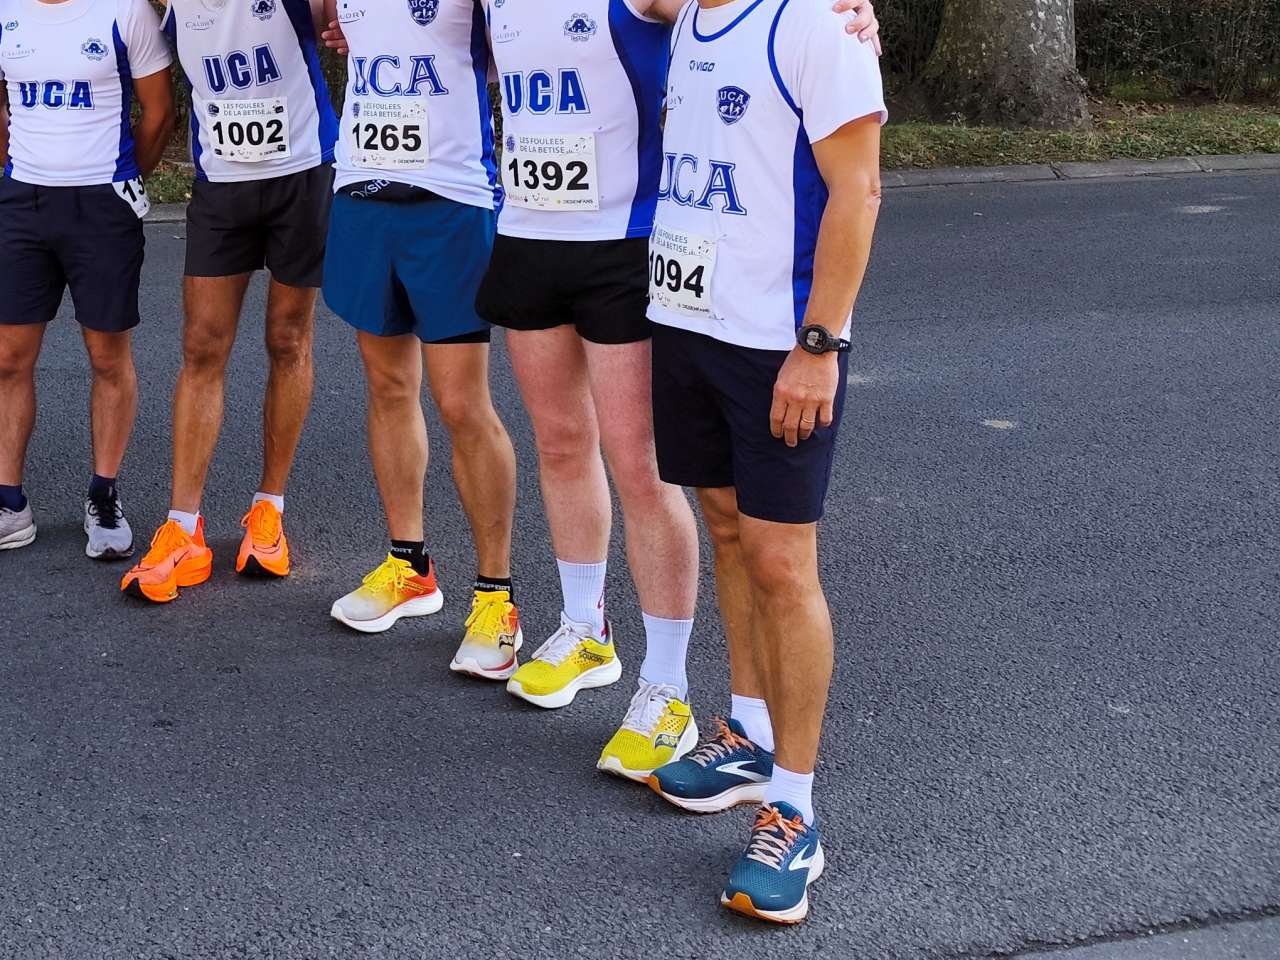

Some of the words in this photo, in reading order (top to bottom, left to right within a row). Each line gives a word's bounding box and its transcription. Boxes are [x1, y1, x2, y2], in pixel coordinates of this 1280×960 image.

[410, 0, 435, 9] UCA
[202, 42, 282, 95] UCA
[17, 79, 95, 111] UCA
[502, 68, 591, 117] UCA
[720, 91, 745, 105] UCA
[212, 119, 284, 146] 1002
[352, 123, 422, 152] 1265
[508, 157, 590, 191] 1392
[657, 152, 748, 216] UCA
[649, 249, 705, 299] 1094
